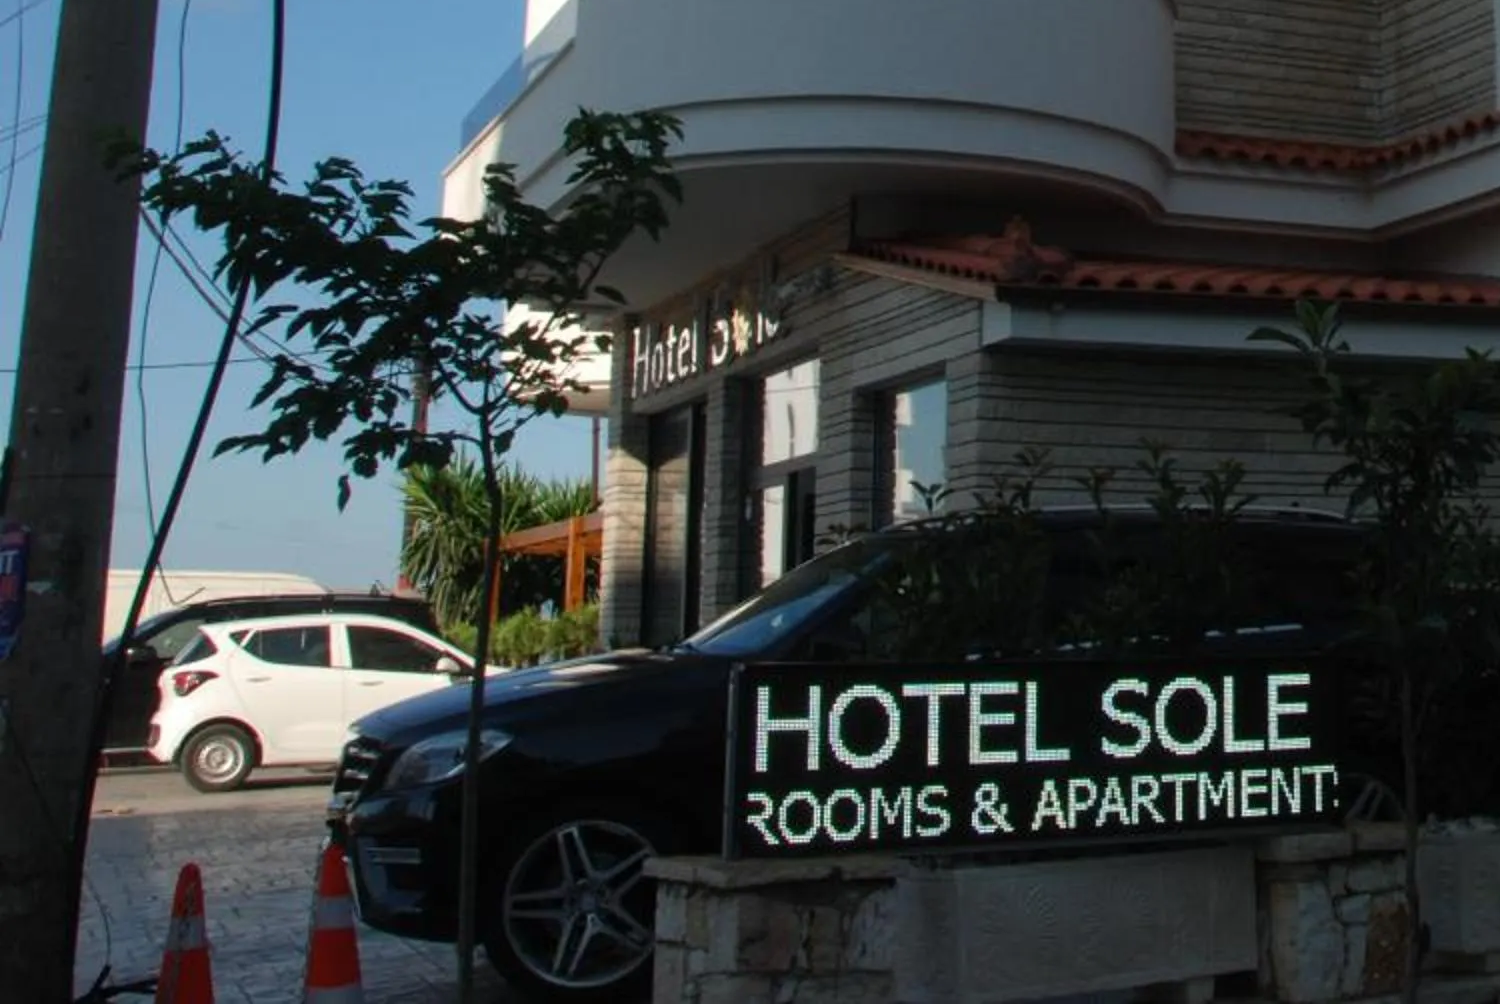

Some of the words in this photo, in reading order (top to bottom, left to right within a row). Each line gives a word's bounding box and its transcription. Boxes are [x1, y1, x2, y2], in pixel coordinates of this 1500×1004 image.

[631, 321, 698, 399] Hotel
[755, 681, 1071, 773] HOTEL
[1101, 673, 1311, 759] SOLE
[746, 784, 952, 846] ROOMS
[970, 782, 1015, 835] &
[1031, 764, 1339, 831] APARTMENT
